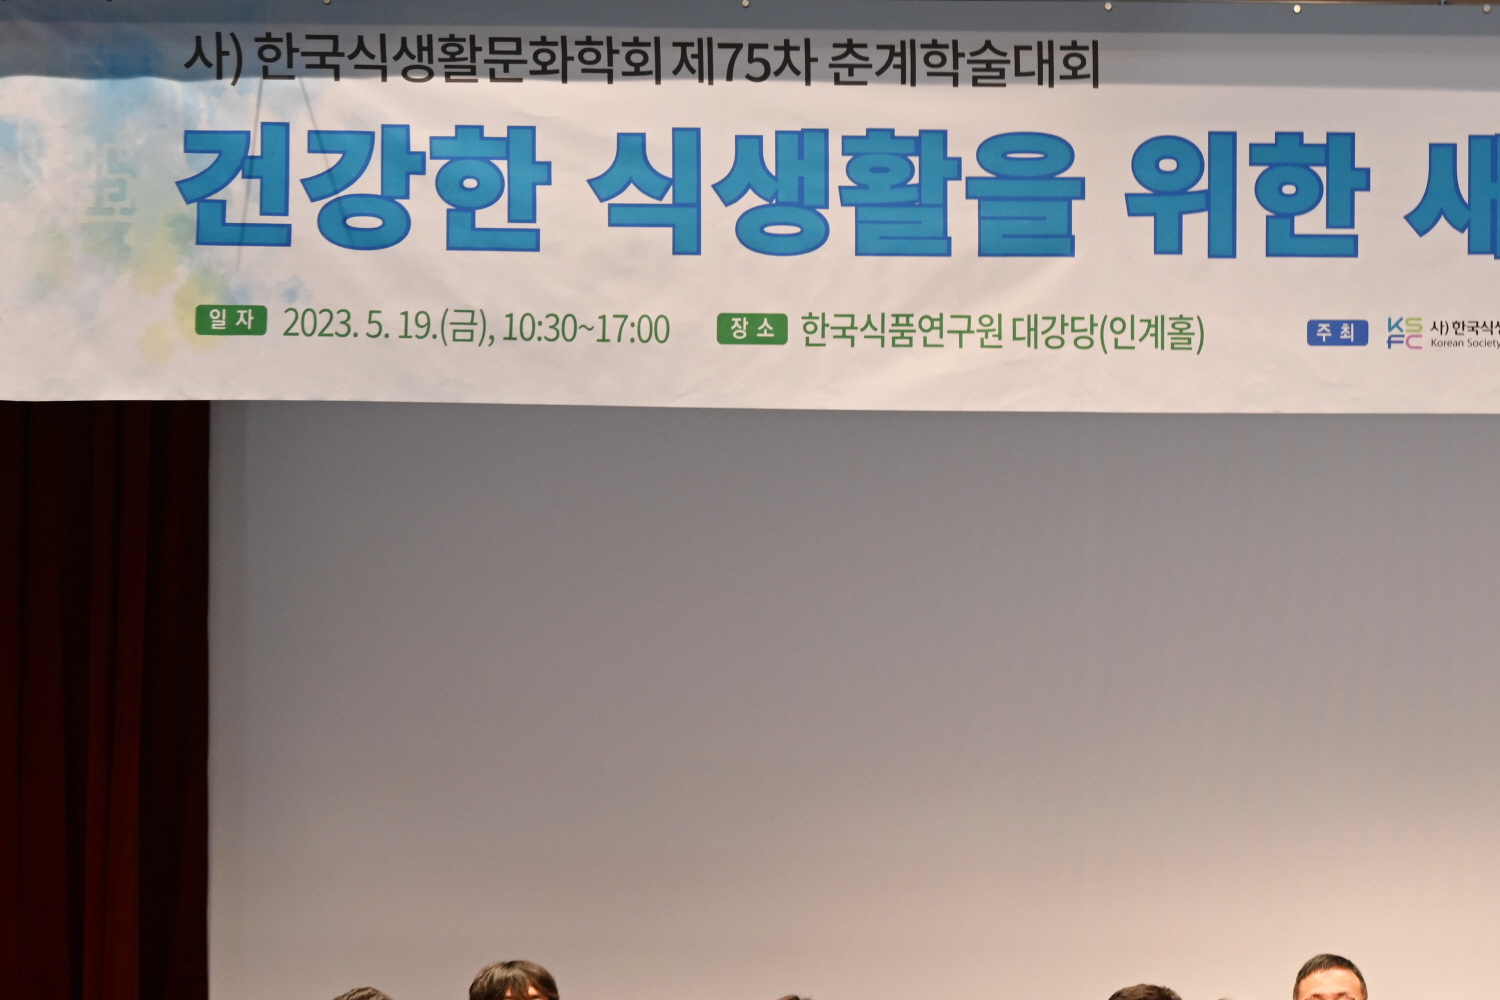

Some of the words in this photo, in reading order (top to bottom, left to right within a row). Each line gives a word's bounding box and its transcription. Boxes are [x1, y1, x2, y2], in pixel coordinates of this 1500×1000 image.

[672, 36, 818, 86] 제75차
[828, 39, 1099, 88] 춘계학술대회
[175, 121, 551, 251] 건강한
[588, 126, 1085, 257] 식생활을
[1125, 131, 1371, 259] 위한
[283, 308, 358, 337] 2023.
[366, 310, 389, 338] 5.
[503, 313, 670, 343] 10:30~17:00
[801, 312, 1002, 348] 한국식품연구원
[1013, 314, 1204, 355] 대강당(인계홀)
[1430, 338, 1465, 348] Korean
